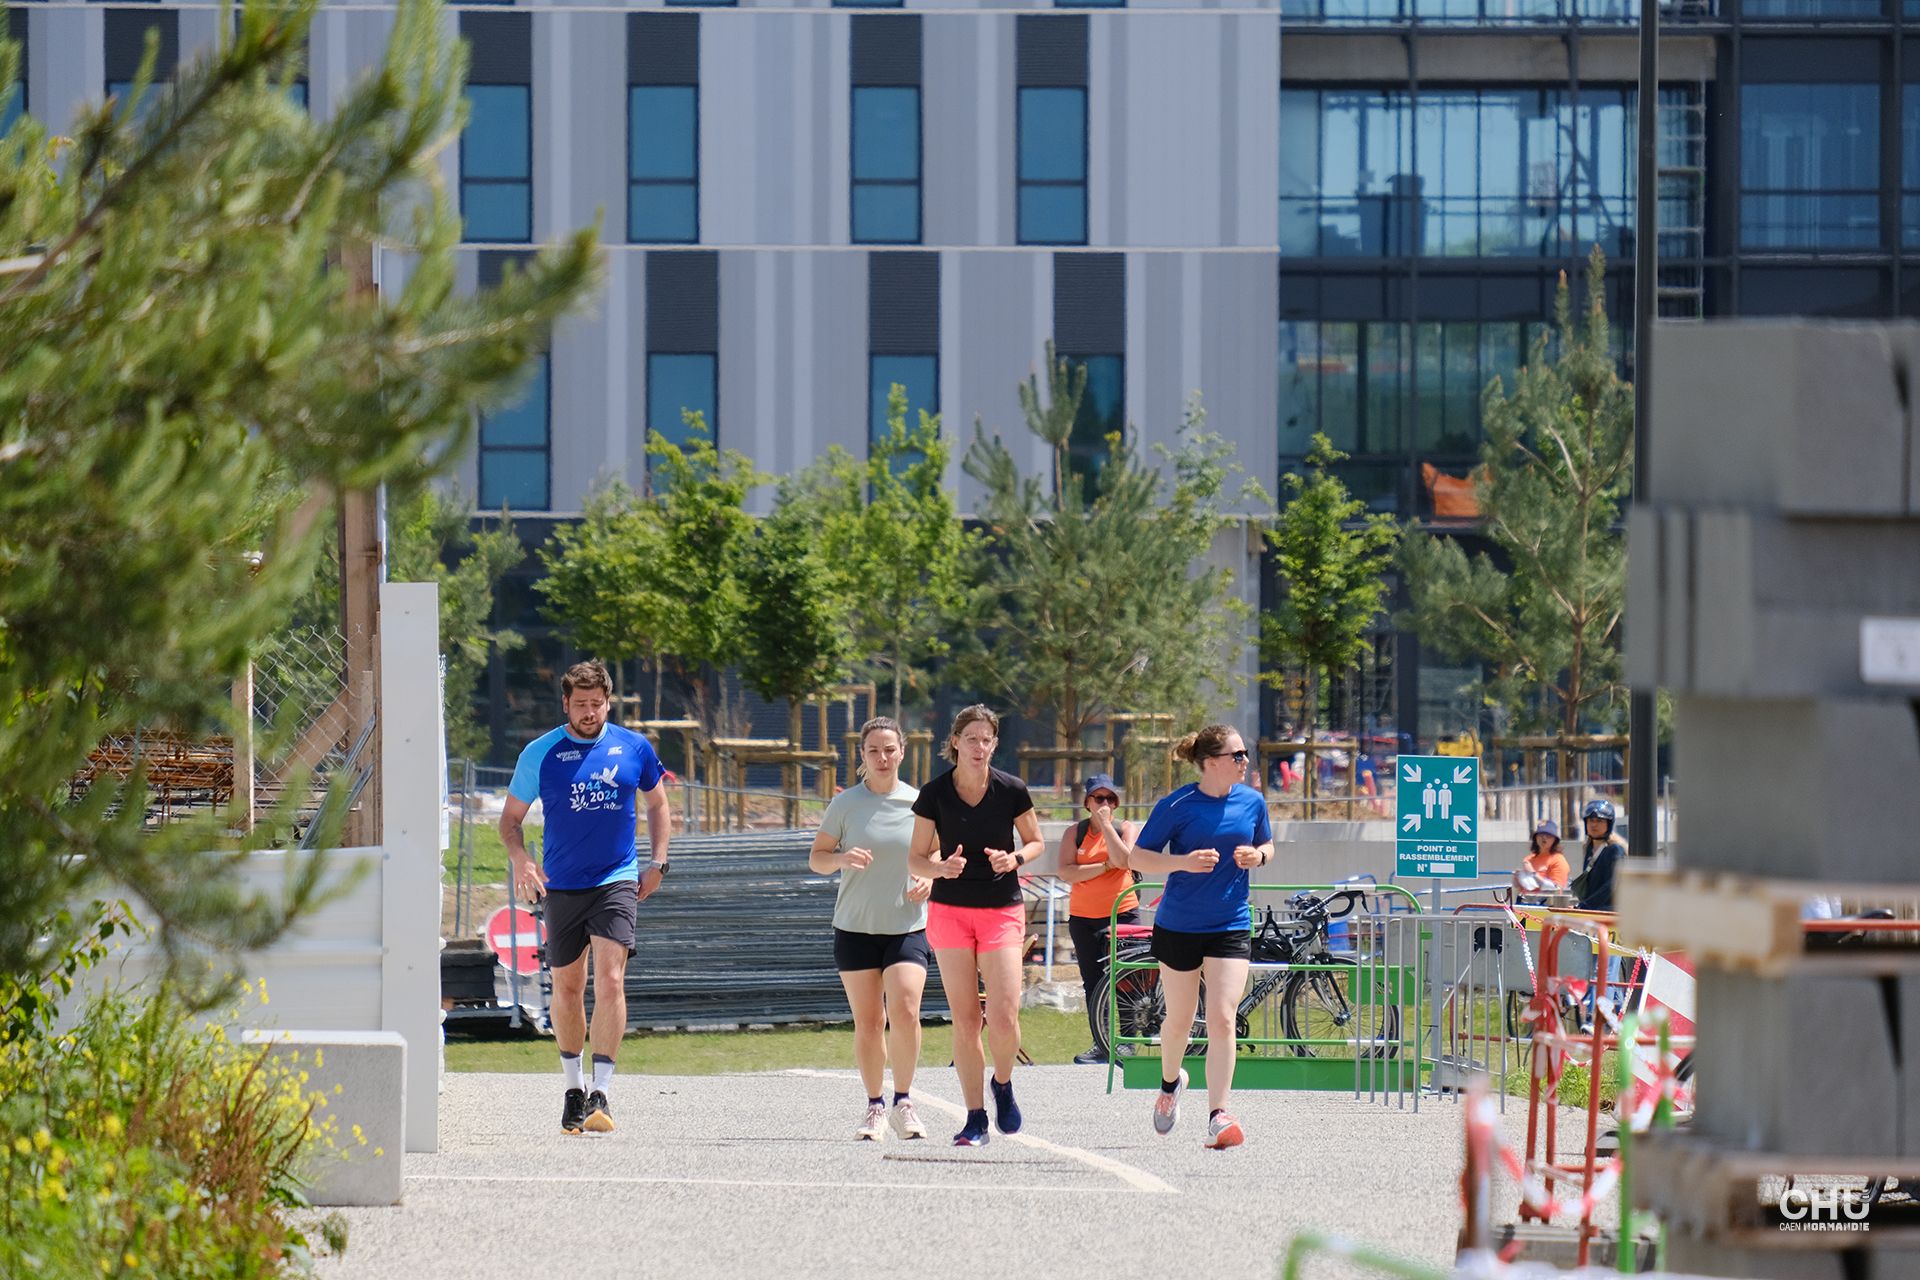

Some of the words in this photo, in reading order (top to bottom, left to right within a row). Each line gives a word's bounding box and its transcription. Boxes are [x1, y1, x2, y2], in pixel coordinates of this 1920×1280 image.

[571, 781, 601, 794] 1944
[590, 790, 618, 803] 2024
[1399, 853, 1475, 862] RASSEMBLEMENT
